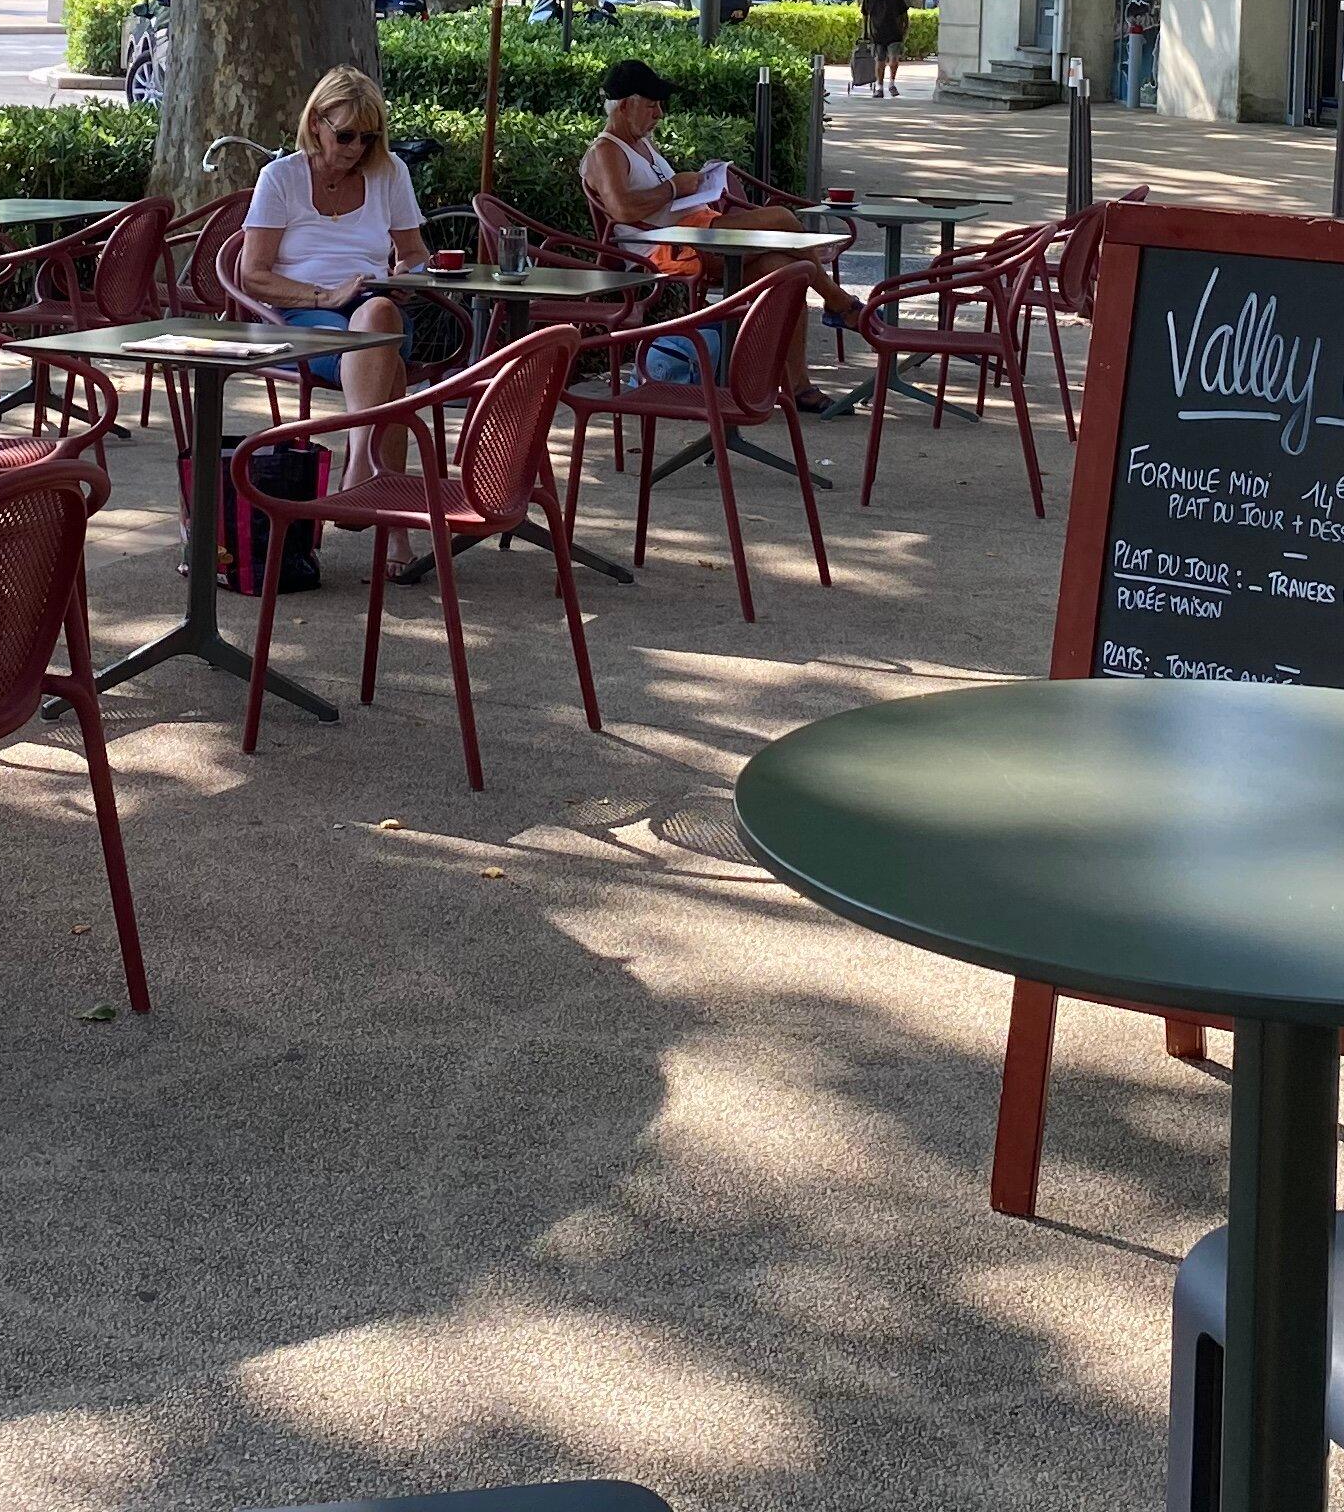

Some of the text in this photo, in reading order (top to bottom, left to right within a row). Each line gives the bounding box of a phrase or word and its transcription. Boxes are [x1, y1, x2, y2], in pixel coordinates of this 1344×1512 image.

[1166, 266, 1323, 456] Valley
[1127, 444, 1220, 494] FORMULE
[1168, 493, 1207, 520] PLAT
[1212, 502, 1235, 523] DU
[1237, 502, 1284, 531] JOUR
[1113, 539, 1152, 570] PLAT
[1157, 552, 1181, 576] DU
[1184, 557, 1229, 587] JOUR
[1268, 572, 1336, 605] TRAVERS
[1117, 585, 1165, 614] PURÉE
